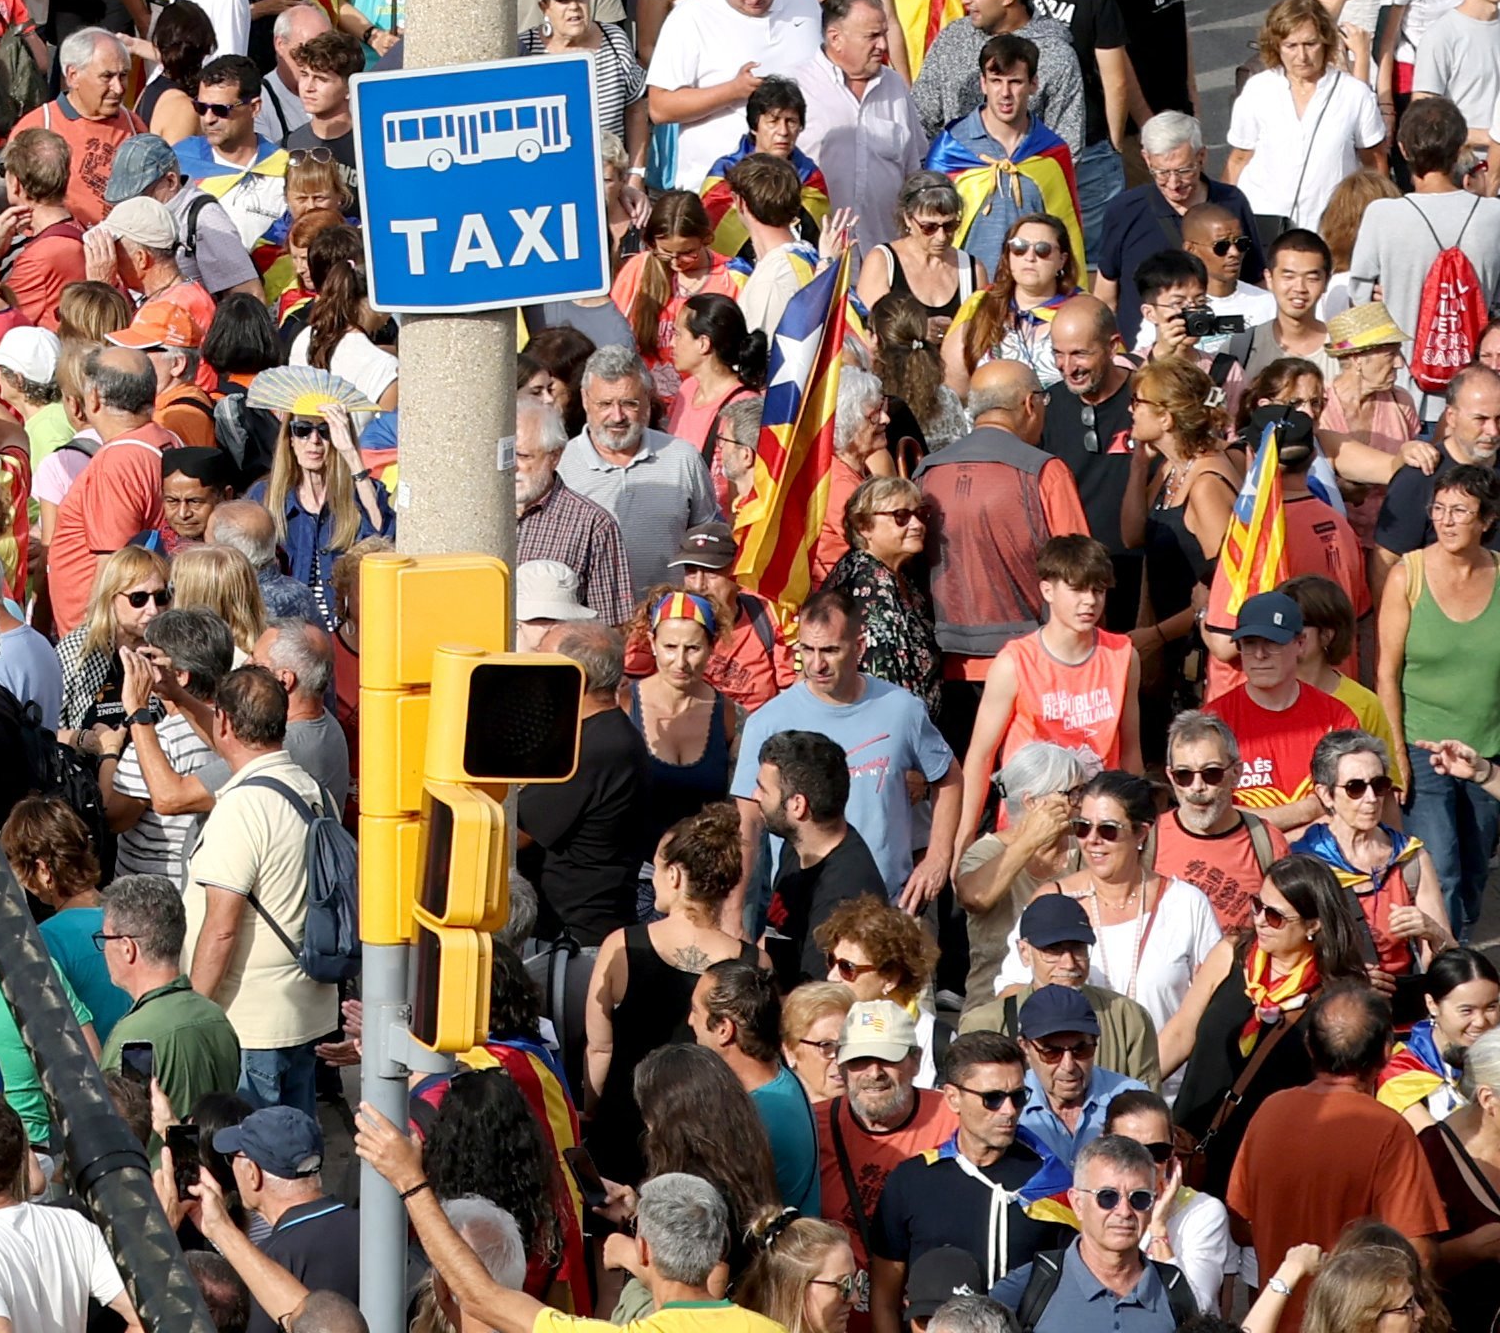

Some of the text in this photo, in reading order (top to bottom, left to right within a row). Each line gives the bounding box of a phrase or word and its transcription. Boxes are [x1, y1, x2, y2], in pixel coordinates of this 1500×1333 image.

[390, 202, 580, 276] TAXI
[1043, 686, 1112, 721] REPÚBLICA
[1063, 705, 1115, 730] CATALANA
[1255, 757, 1273, 774] ÉS
[1238, 773, 1273, 789] ORA
